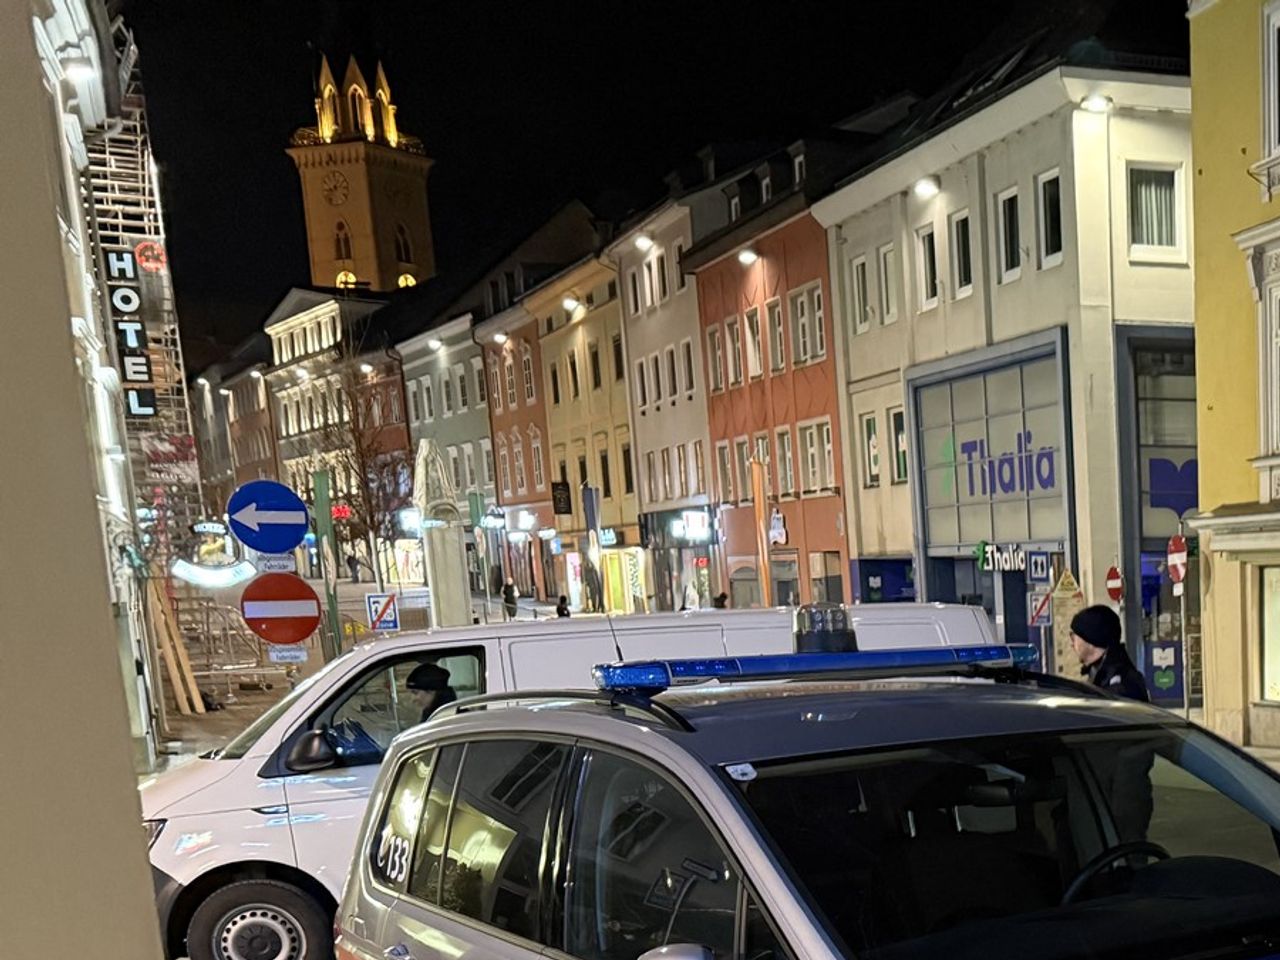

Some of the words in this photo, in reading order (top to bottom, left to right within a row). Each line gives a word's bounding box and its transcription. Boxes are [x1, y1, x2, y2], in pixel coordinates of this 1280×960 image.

[108, 252, 155, 415] HOTEL
[961, 431, 1056, 497] Thalia
[386, 835, 410, 883] 133
